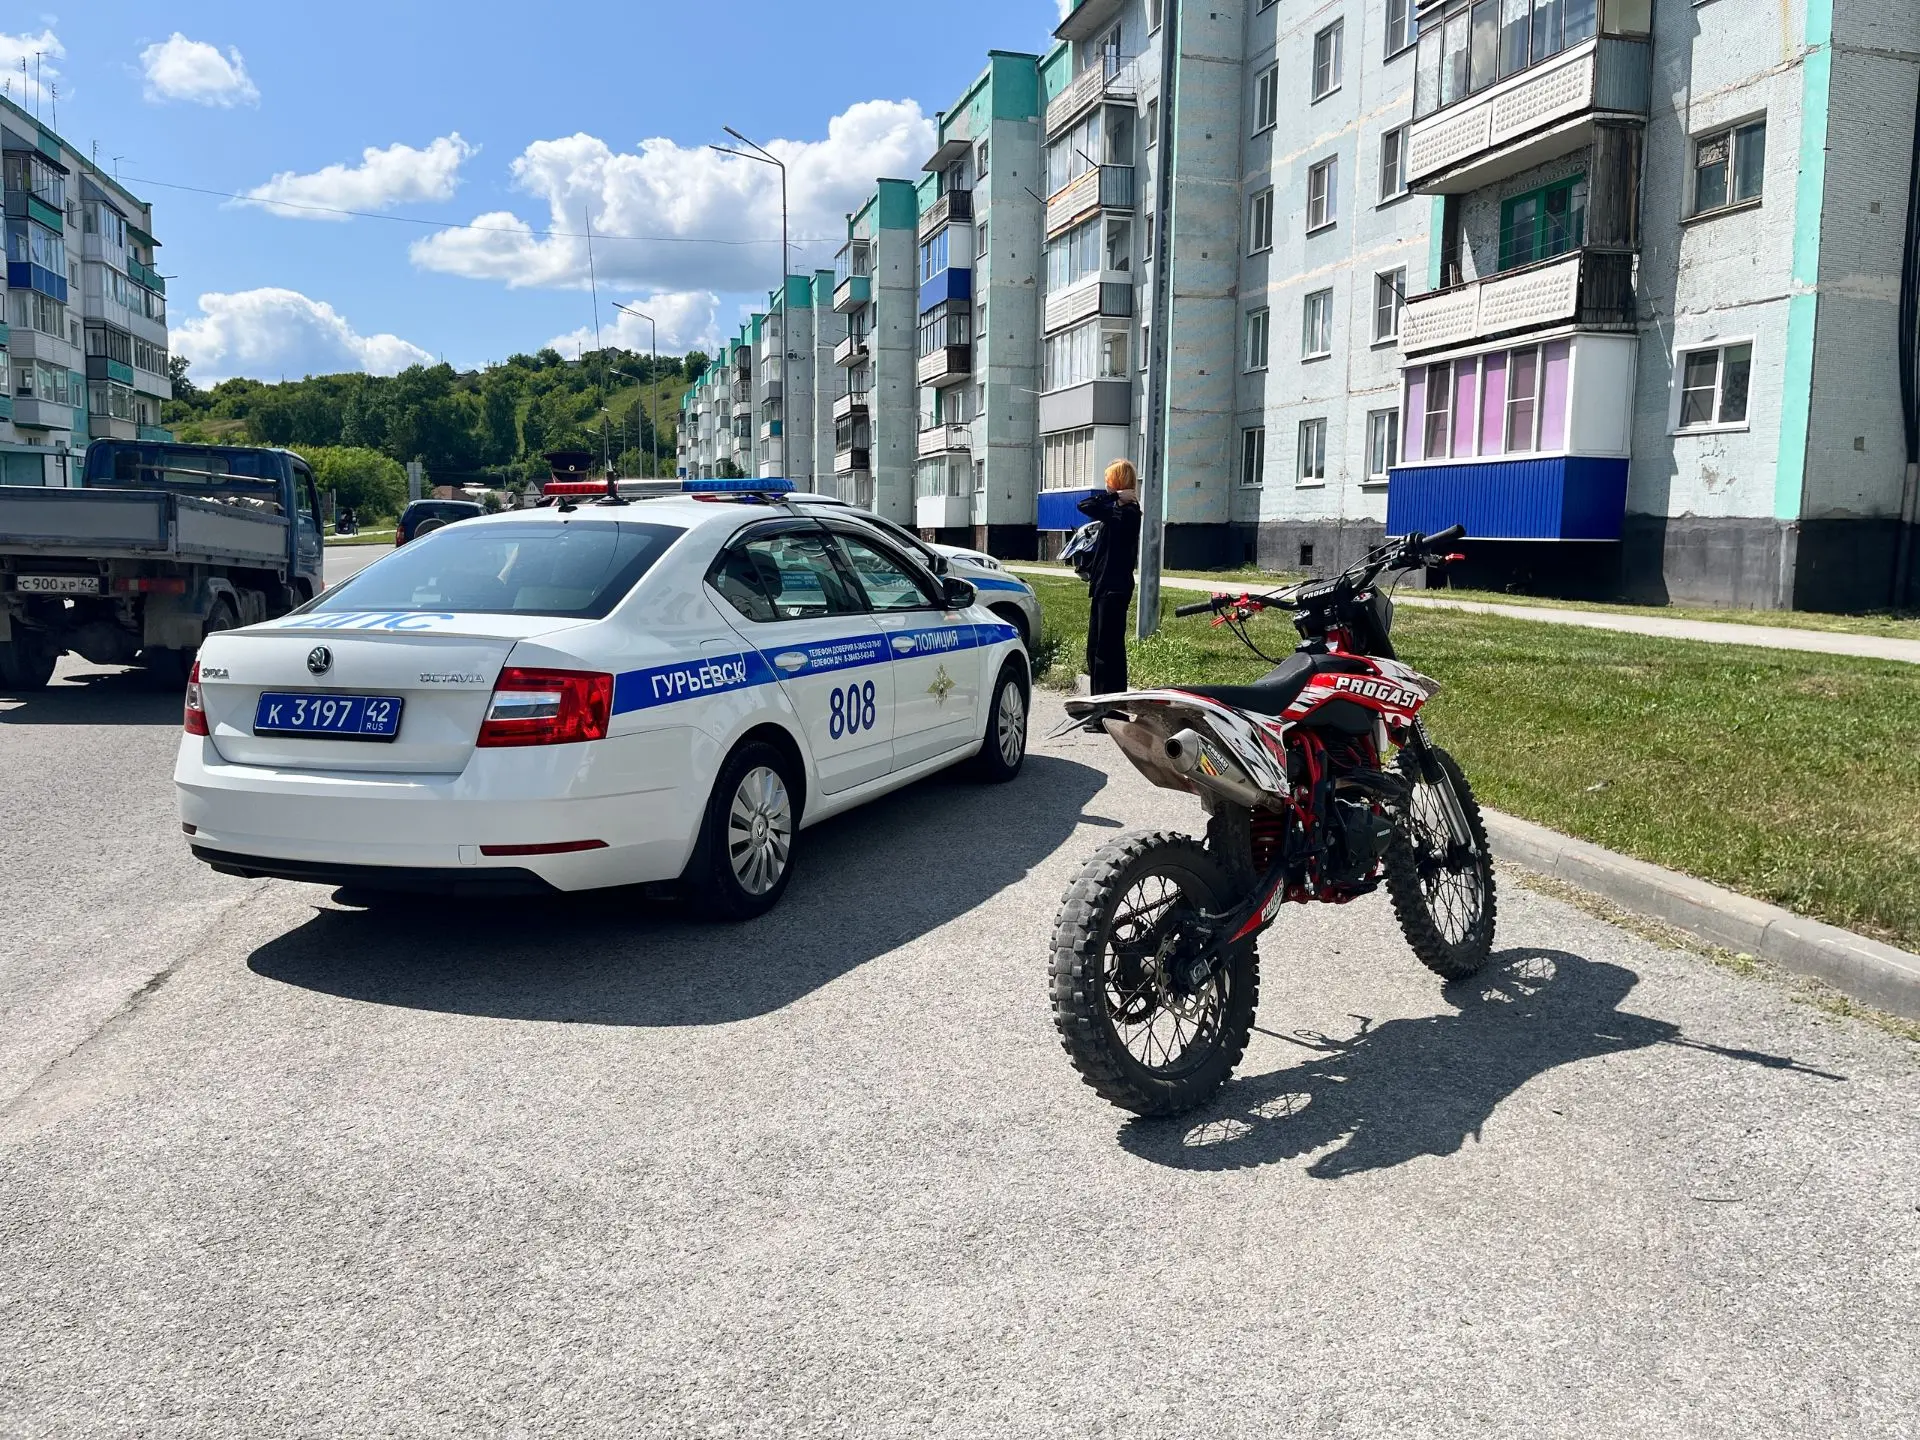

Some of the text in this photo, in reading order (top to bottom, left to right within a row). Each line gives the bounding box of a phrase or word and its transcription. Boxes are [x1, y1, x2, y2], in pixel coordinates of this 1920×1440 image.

[1302, 586, 1336, 600] PROGAS
[280, 613, 454, 630] ДПС
[913, 630, 959, 652] ПОЛИЦИЯ
[808, 647, 833, 658] ТЕЛЕФОН
[832, 643, 854, 655] ДОВЕРИЯ
[811, 656, 835, 668] ТЕЛЕФОН
[419, 673, 485, 683] OCTAVIA
[651, 661, 747, 699] ГУРЬЕВСК
[1335, 676, 1419, 708] PROGASI
[366, 701, 391, 722] 42
[829, 680, 876, 740] 808
[365, 722, 384, 731] RUS
